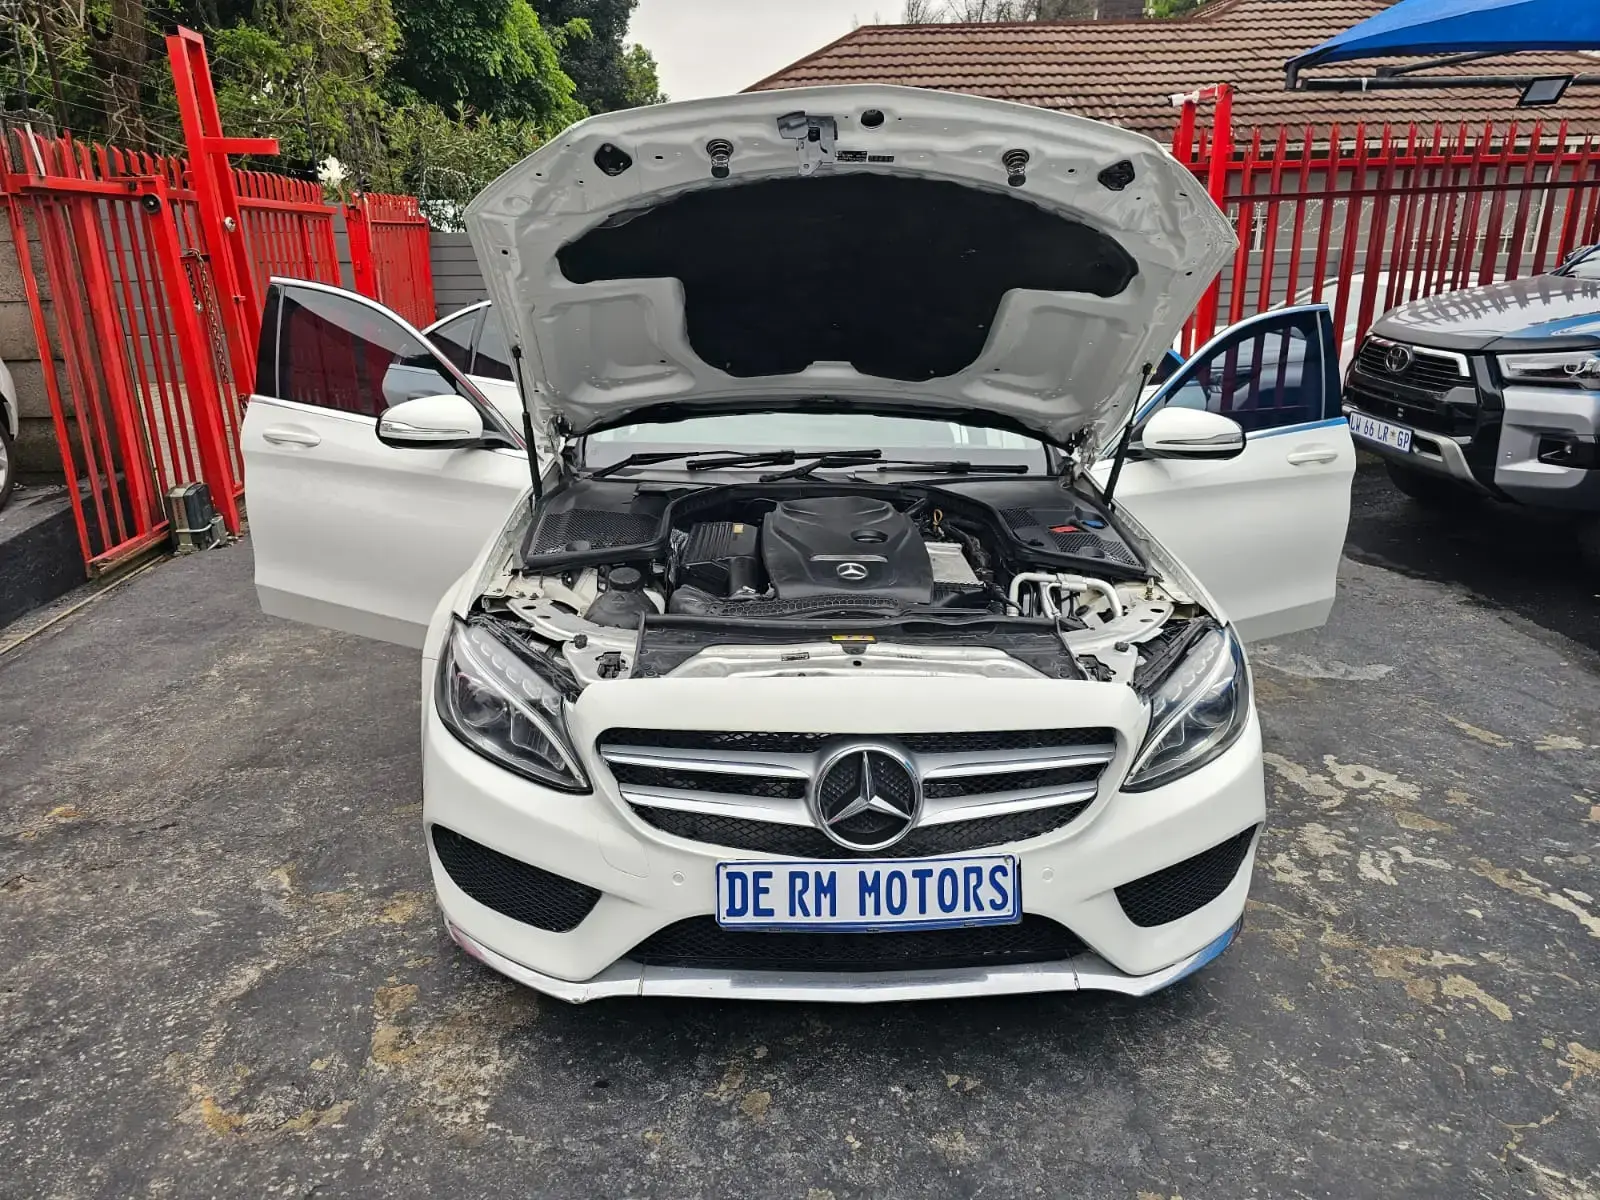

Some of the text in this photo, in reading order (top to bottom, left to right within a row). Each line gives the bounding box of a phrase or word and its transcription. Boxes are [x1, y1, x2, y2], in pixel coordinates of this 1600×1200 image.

[1364, 420, 1374, 437] 66
[1378, 424, 1389, 441] LR
[1397, 431, 1410, 448] GP
[725, 864, 1009, 917] DE RM MOTORS
